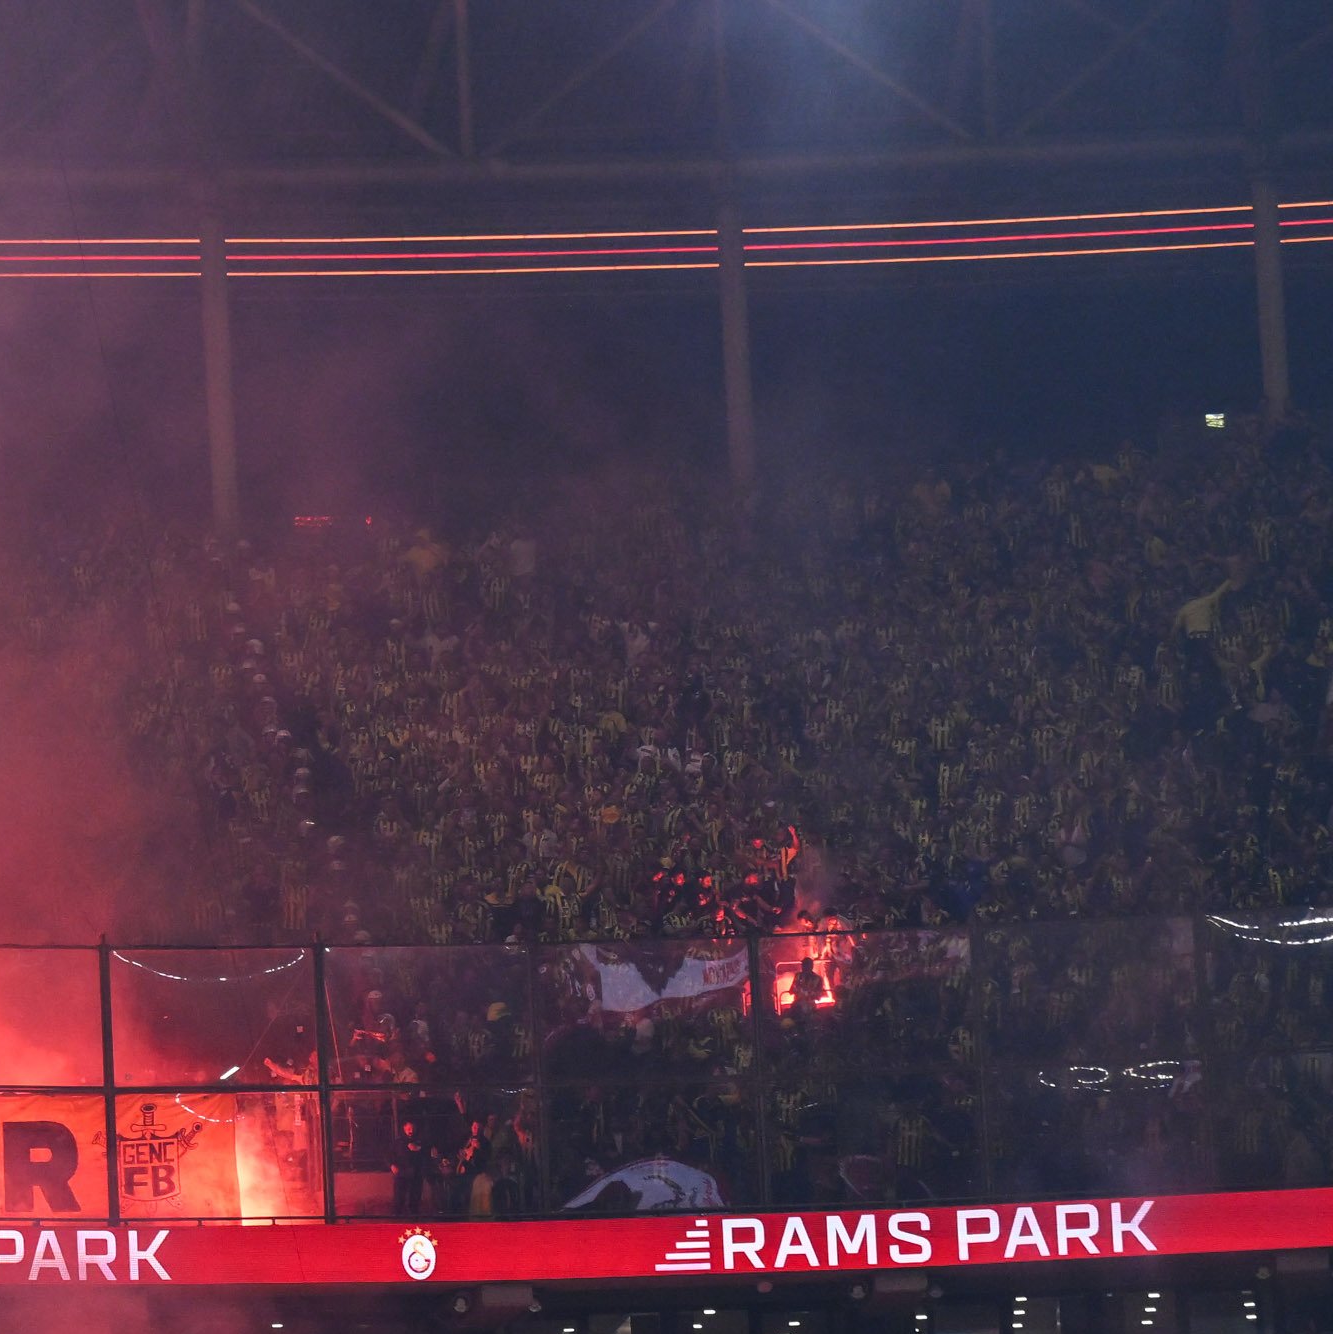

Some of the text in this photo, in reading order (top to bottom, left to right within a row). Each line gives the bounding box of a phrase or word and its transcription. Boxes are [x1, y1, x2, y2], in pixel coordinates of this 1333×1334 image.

[124, 1165, 175, 1197] FB
[722, 1201, 1157, 1269] RAMS PARK
